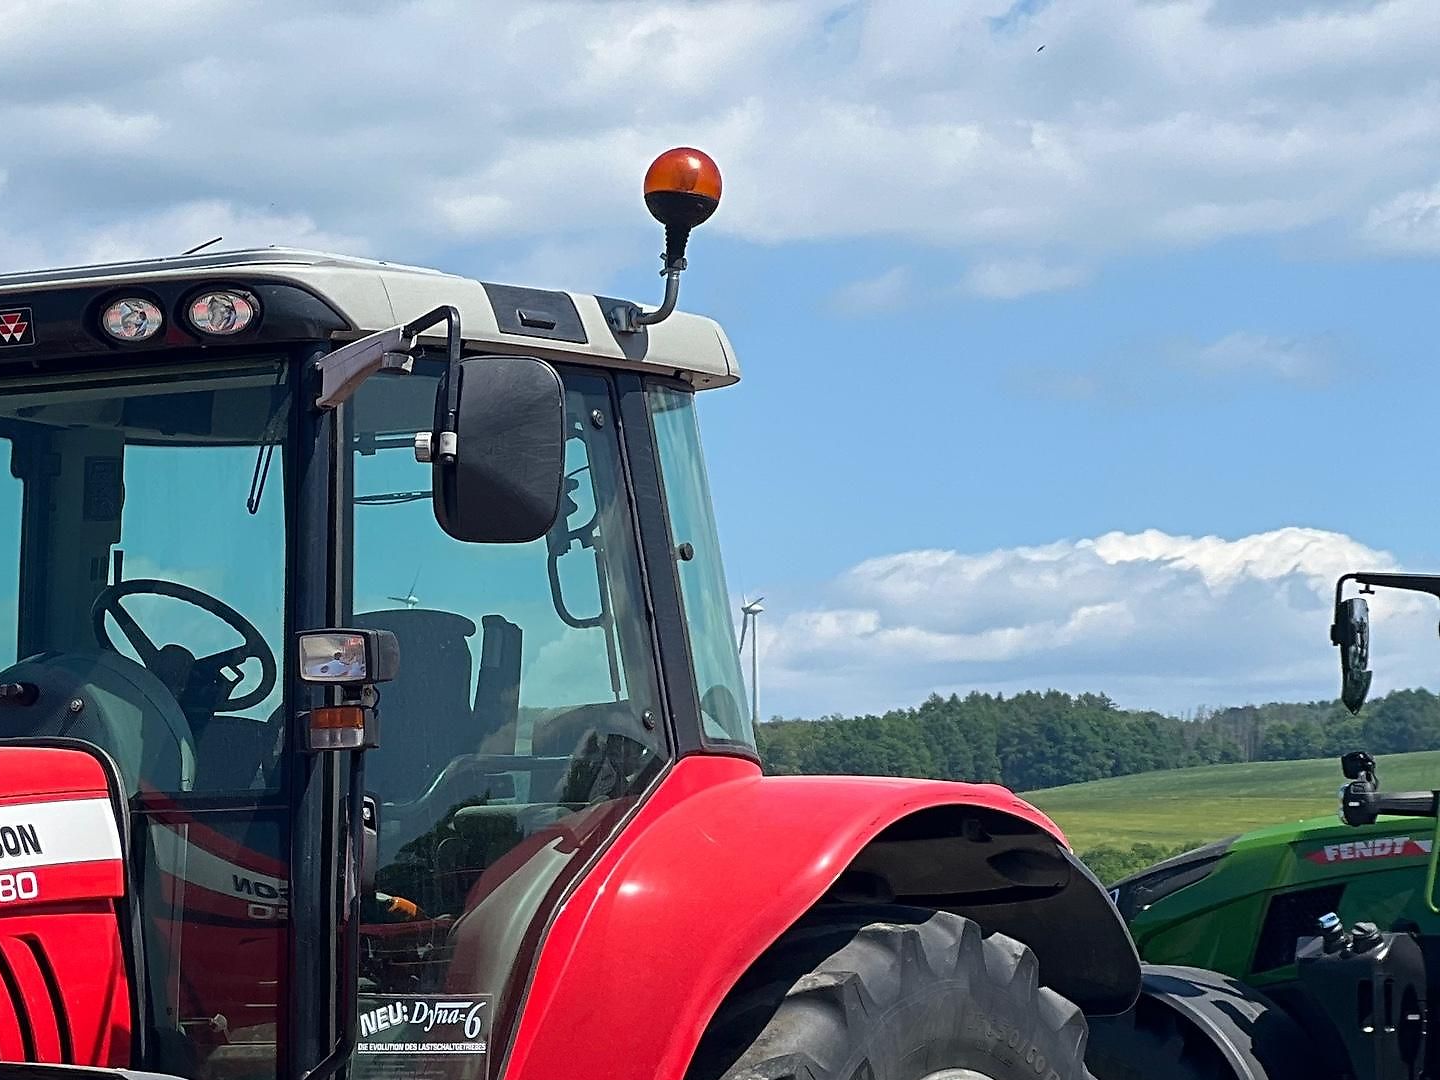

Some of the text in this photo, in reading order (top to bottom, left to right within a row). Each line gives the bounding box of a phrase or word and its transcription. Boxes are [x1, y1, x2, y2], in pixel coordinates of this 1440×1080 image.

[1324, 836, 1410, 861] FENDT
[360, 1001, 487, 1039] NEU: Dyna-6
[369, 1043, 404, 1051] EVOLUTION
[405, 1043, 417, 1051] DES
